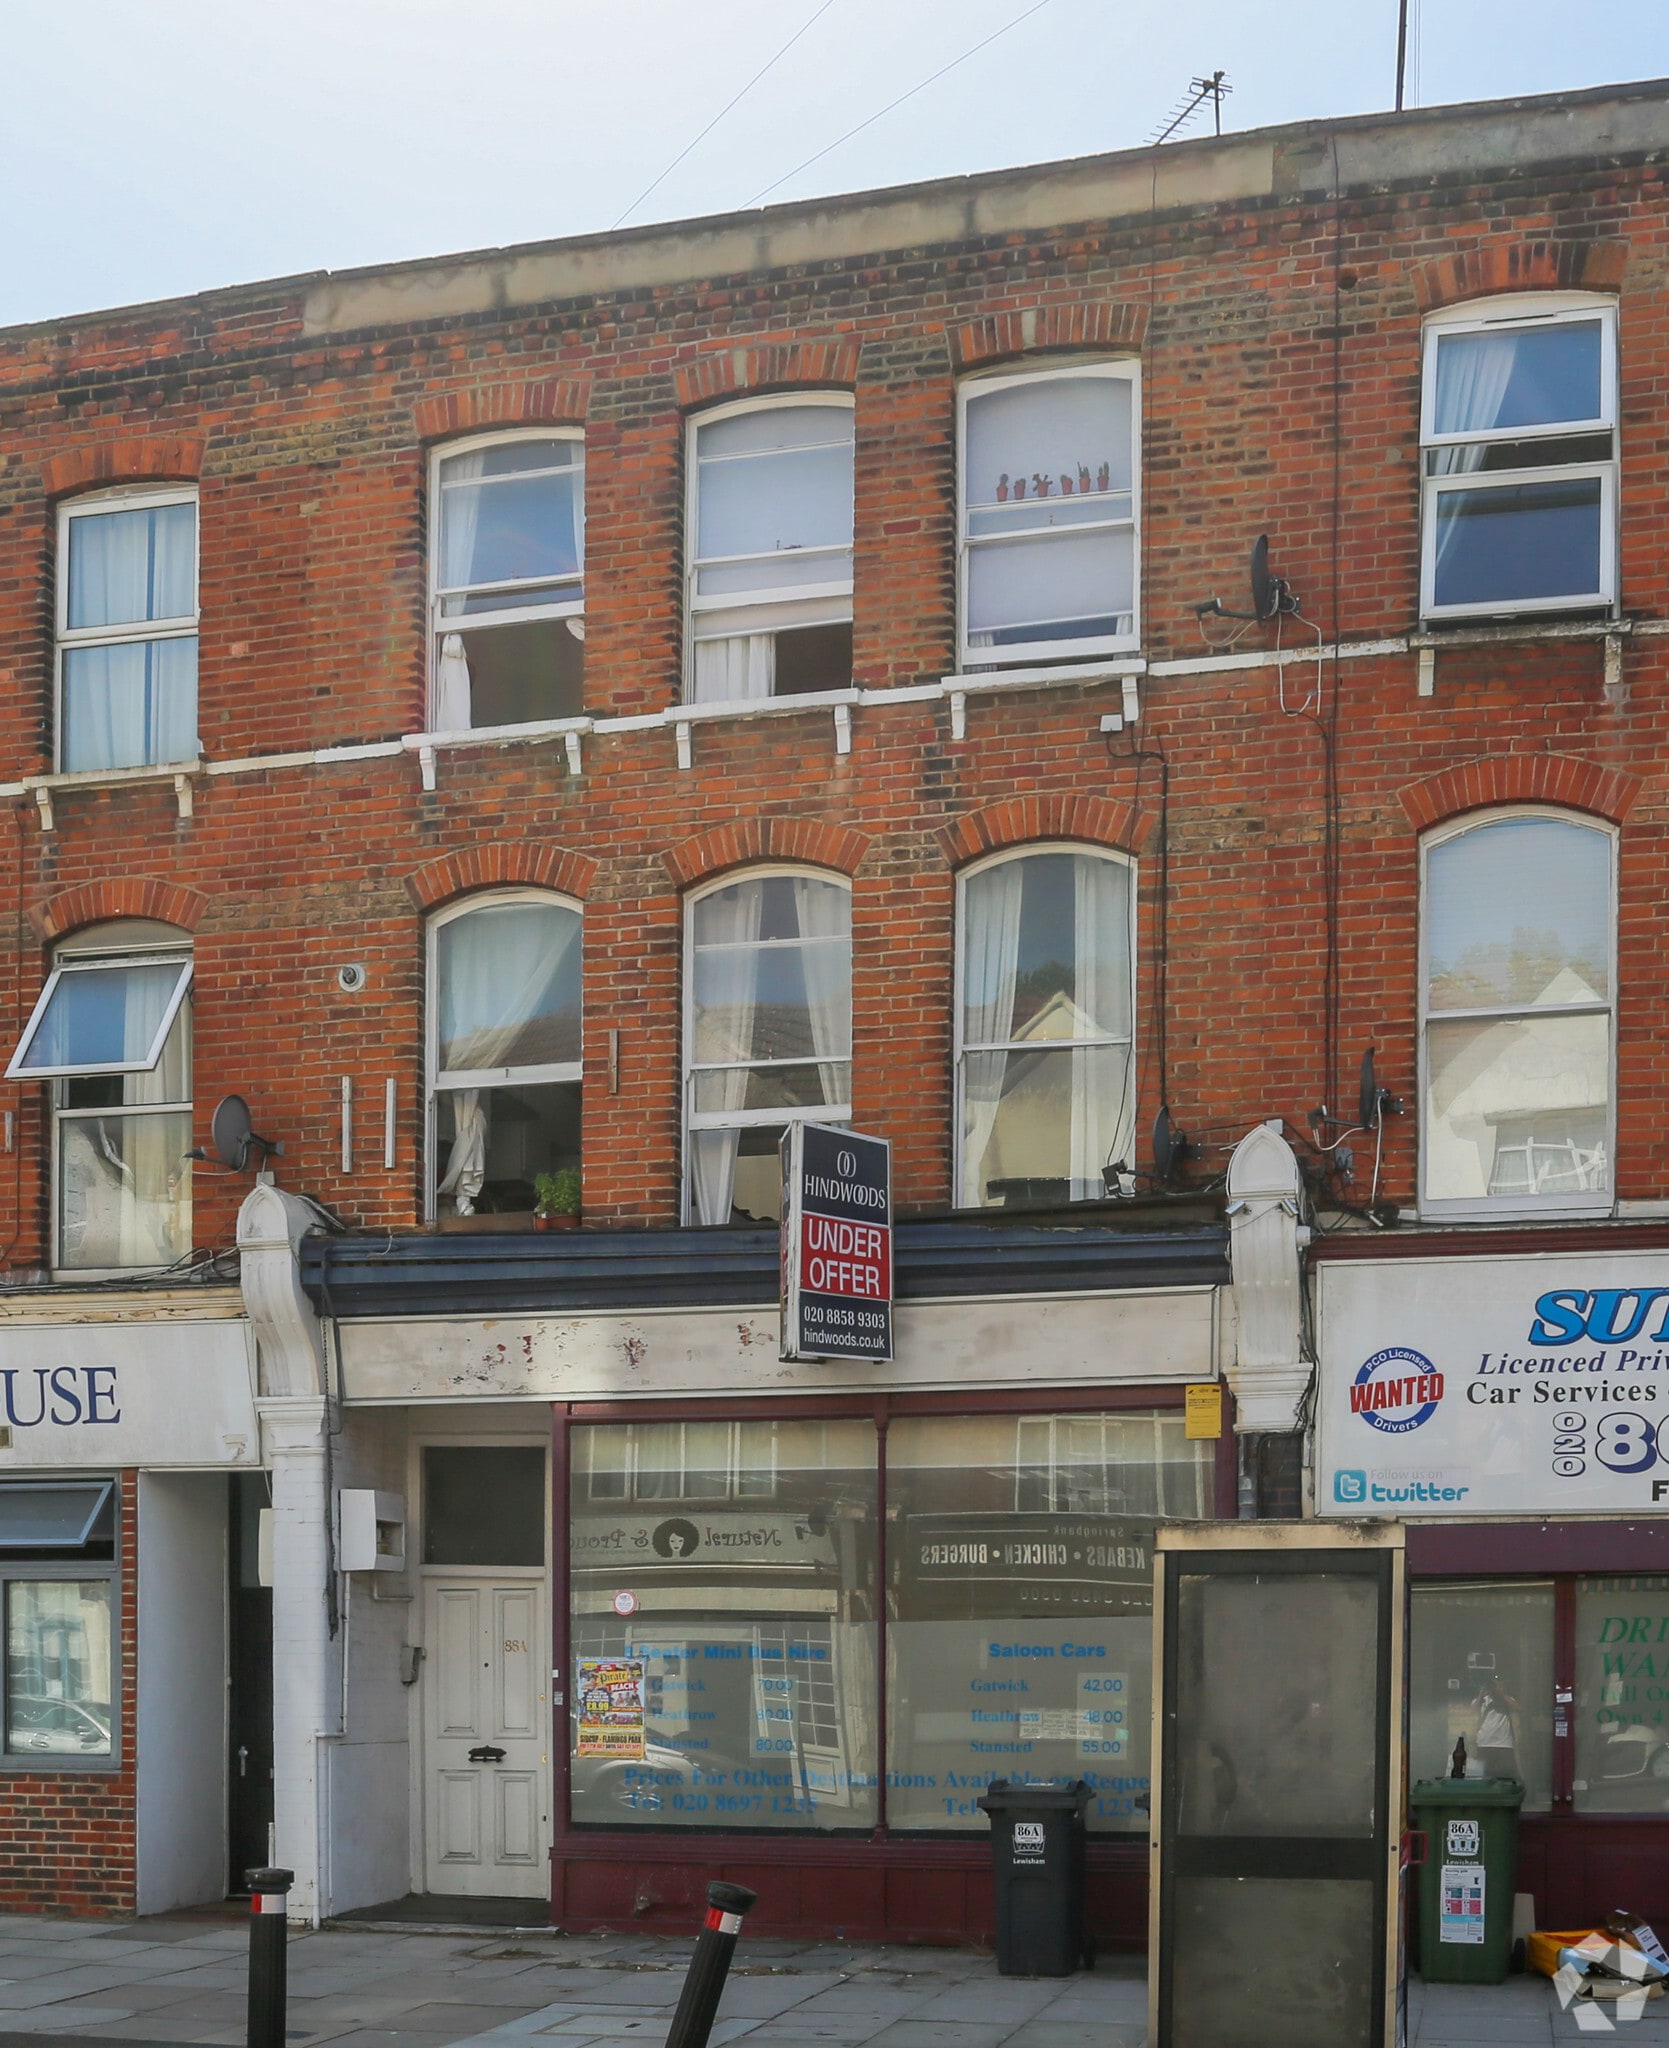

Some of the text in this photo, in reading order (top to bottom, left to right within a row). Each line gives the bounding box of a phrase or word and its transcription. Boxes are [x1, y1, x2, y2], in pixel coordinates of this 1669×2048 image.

[805, 1174, 886, 1209] HINDWOODS
[808, 1218, 882, 1260] UNDER
[809, 1257, 881, 1296] OFFER
[804, 1305, 885, 1328] 020 8858 9303
[804, 1328, 886, 1349] hindwoods.co.uk
[1365, 1349, 1432, 1373] PCO Licensed
[1477, 1350, 1607, 1375] Licenced
[0, 1366, 121, 1426] USE
[1349, 1372, 1444, 1413] WANTED
[1466, 1380, 1657, 1405] Car Services
[1374, 1418, 1418, 1432] Drivers
[1594, 1411, 1669, 1474] 8
[1371, 1469, 1443, 1480] Follow us on
[1371, 1482, 1470, 1502] twitter
[639, 1644, 699, 1660] Seater
[704, 1644, 743, 1660] Mini
[747, 1644, 783, 1660] Bus
[787, 1644, 826, 1660] Hire
[988, 1642, 1107, 1658] Saloon Cars
[1602, 1650, 1669, 1679] WA
[611, 1683, 634, 1691] BEACH
[970, 1679, 1123, 1692] Gatwick 42.00
[970, 1708, 1123, 1723] Heathrow 48.00
[755, 1738, 794, 1751] 80.00
[969, 1740, 1122, 1753] Stansted 55.00
[624, 1768, 685, 1787] Prices
[692, 1768, 726, 1787] For
[733, 1768, 793, 1788] Other
[672, 1793, 710, 1811] 020
[714, 1794, 763, 1812] 8697
[1017, 1826, 1040, 1837] 86A
[1450, 1822, 1475, 1834] 86A
